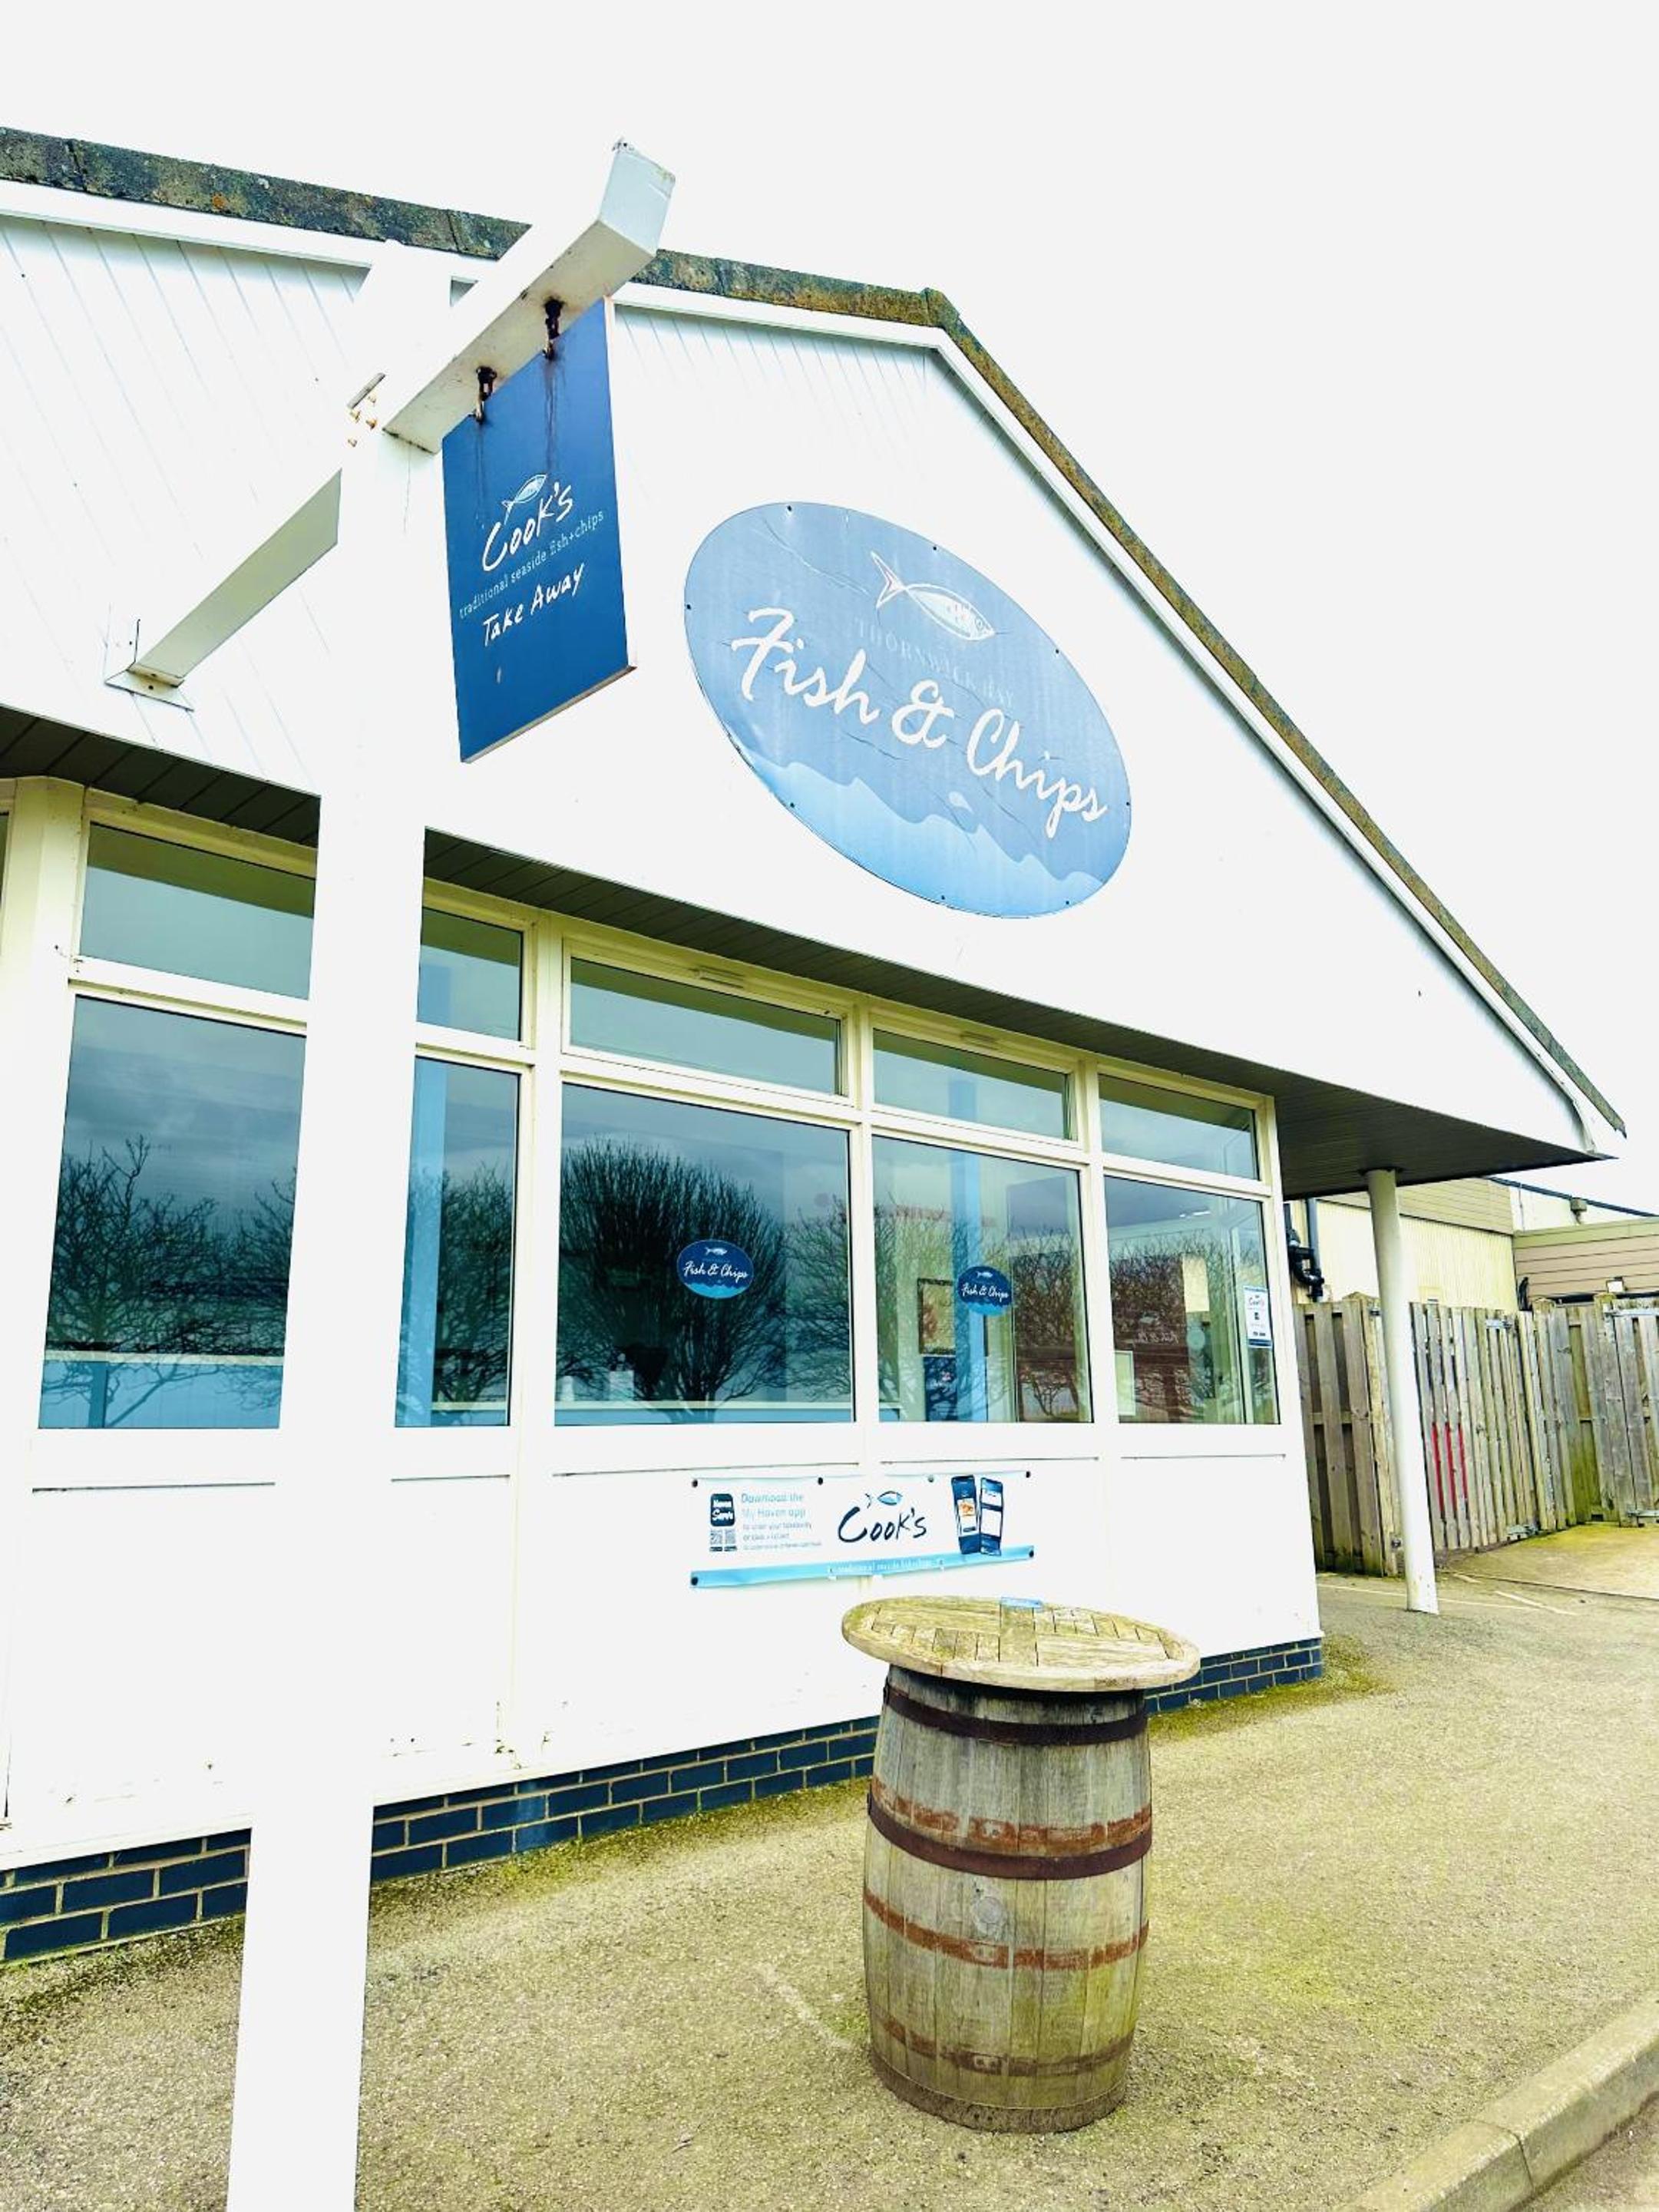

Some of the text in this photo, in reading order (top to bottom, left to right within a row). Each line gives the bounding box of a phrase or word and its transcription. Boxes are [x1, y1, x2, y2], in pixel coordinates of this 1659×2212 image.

[482, 481, 573, 572] Cook's
[460, 580, 509, 619] traditional
[510, 551, 547, 584] seaside
[482, 563, 585, 646] Take Away
[731, 607, 1108, 838] Fish & Chips
[682, 1260, 749, 1284] Fish & Chips
[961, 1282, 978, 1297] Fish
[979, 1285, 987, 1296] &
[838, 1506, 927, 1543] Cook's
